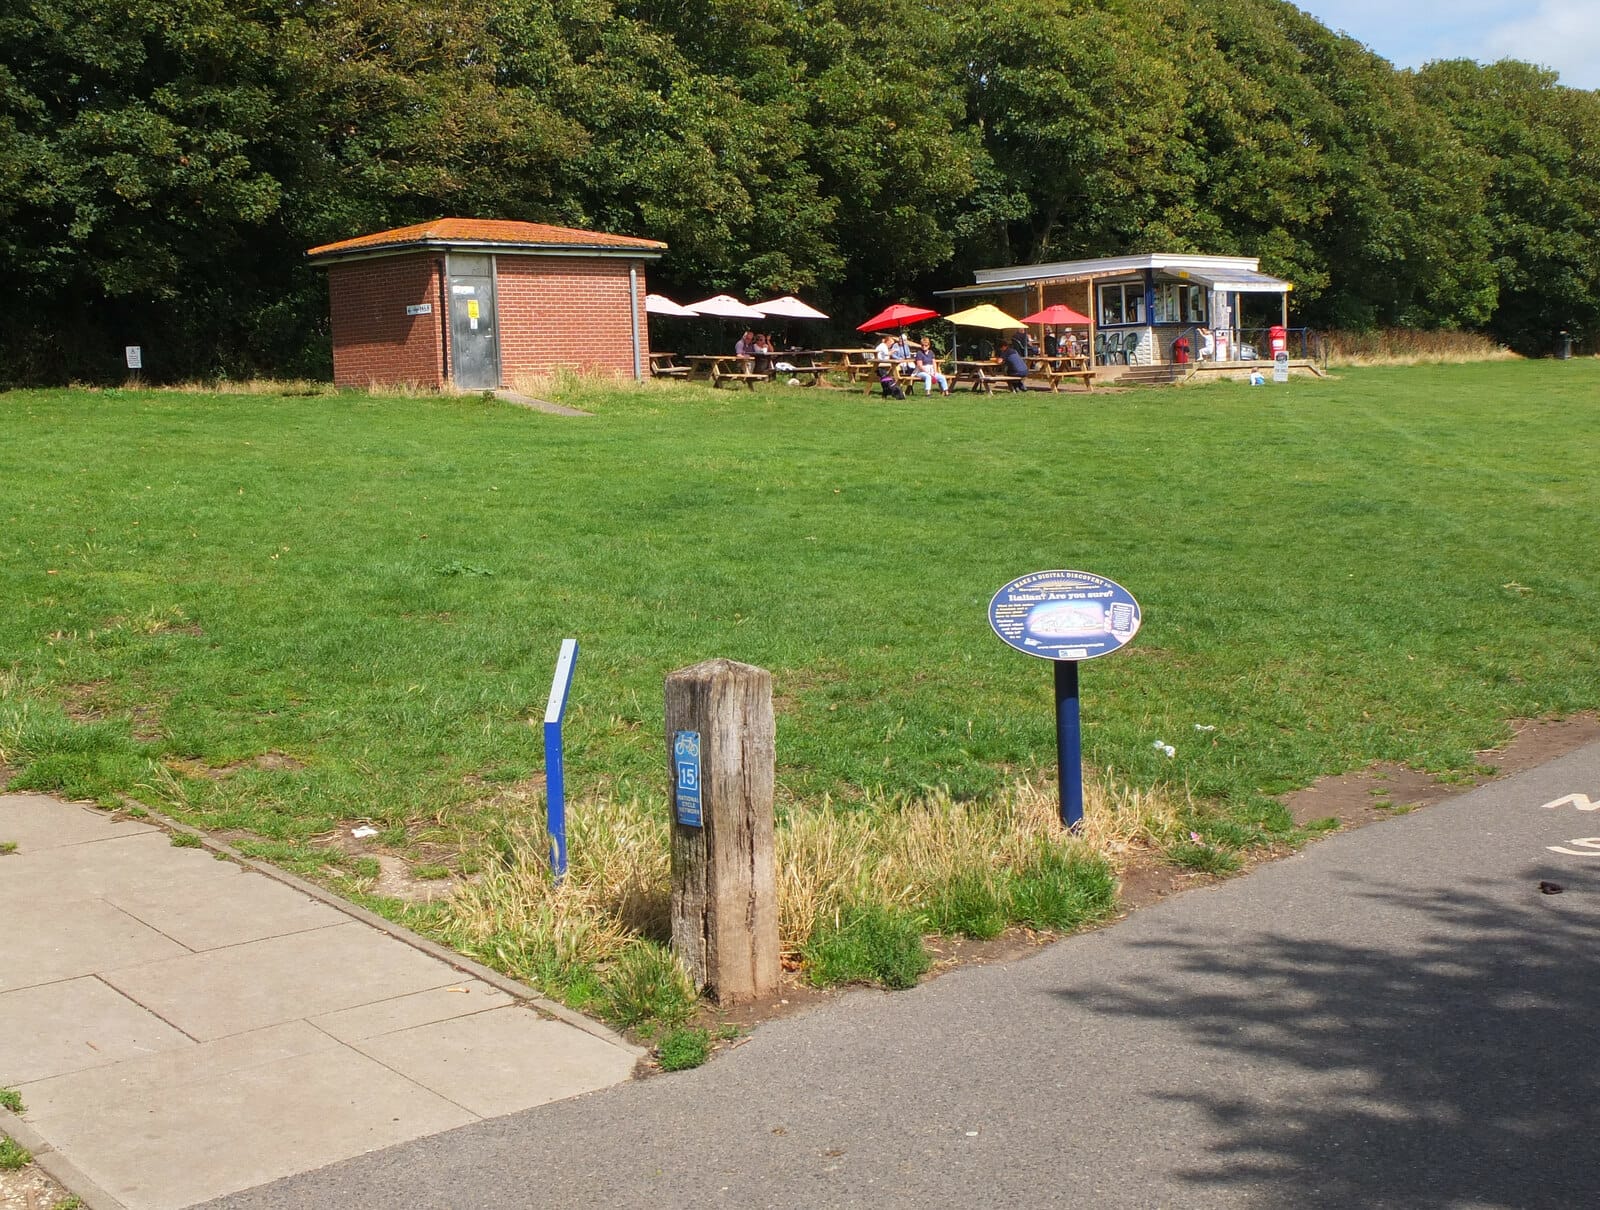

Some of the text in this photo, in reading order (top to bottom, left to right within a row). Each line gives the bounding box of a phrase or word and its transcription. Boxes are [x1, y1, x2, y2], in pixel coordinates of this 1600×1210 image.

[1015, 577, 1032, 588] MAKE
[1037, 572, 1065, 580] DIGITAL
[1066, 572, 1104, 585] DISCOVERY
[1008, 590, 1114, 602] Italian? Are you sure?
[682, 768, 695, 785] 15
[677, 795, 699, 803] NATIONAL
[678, 807, 700, 815] NETWORK
